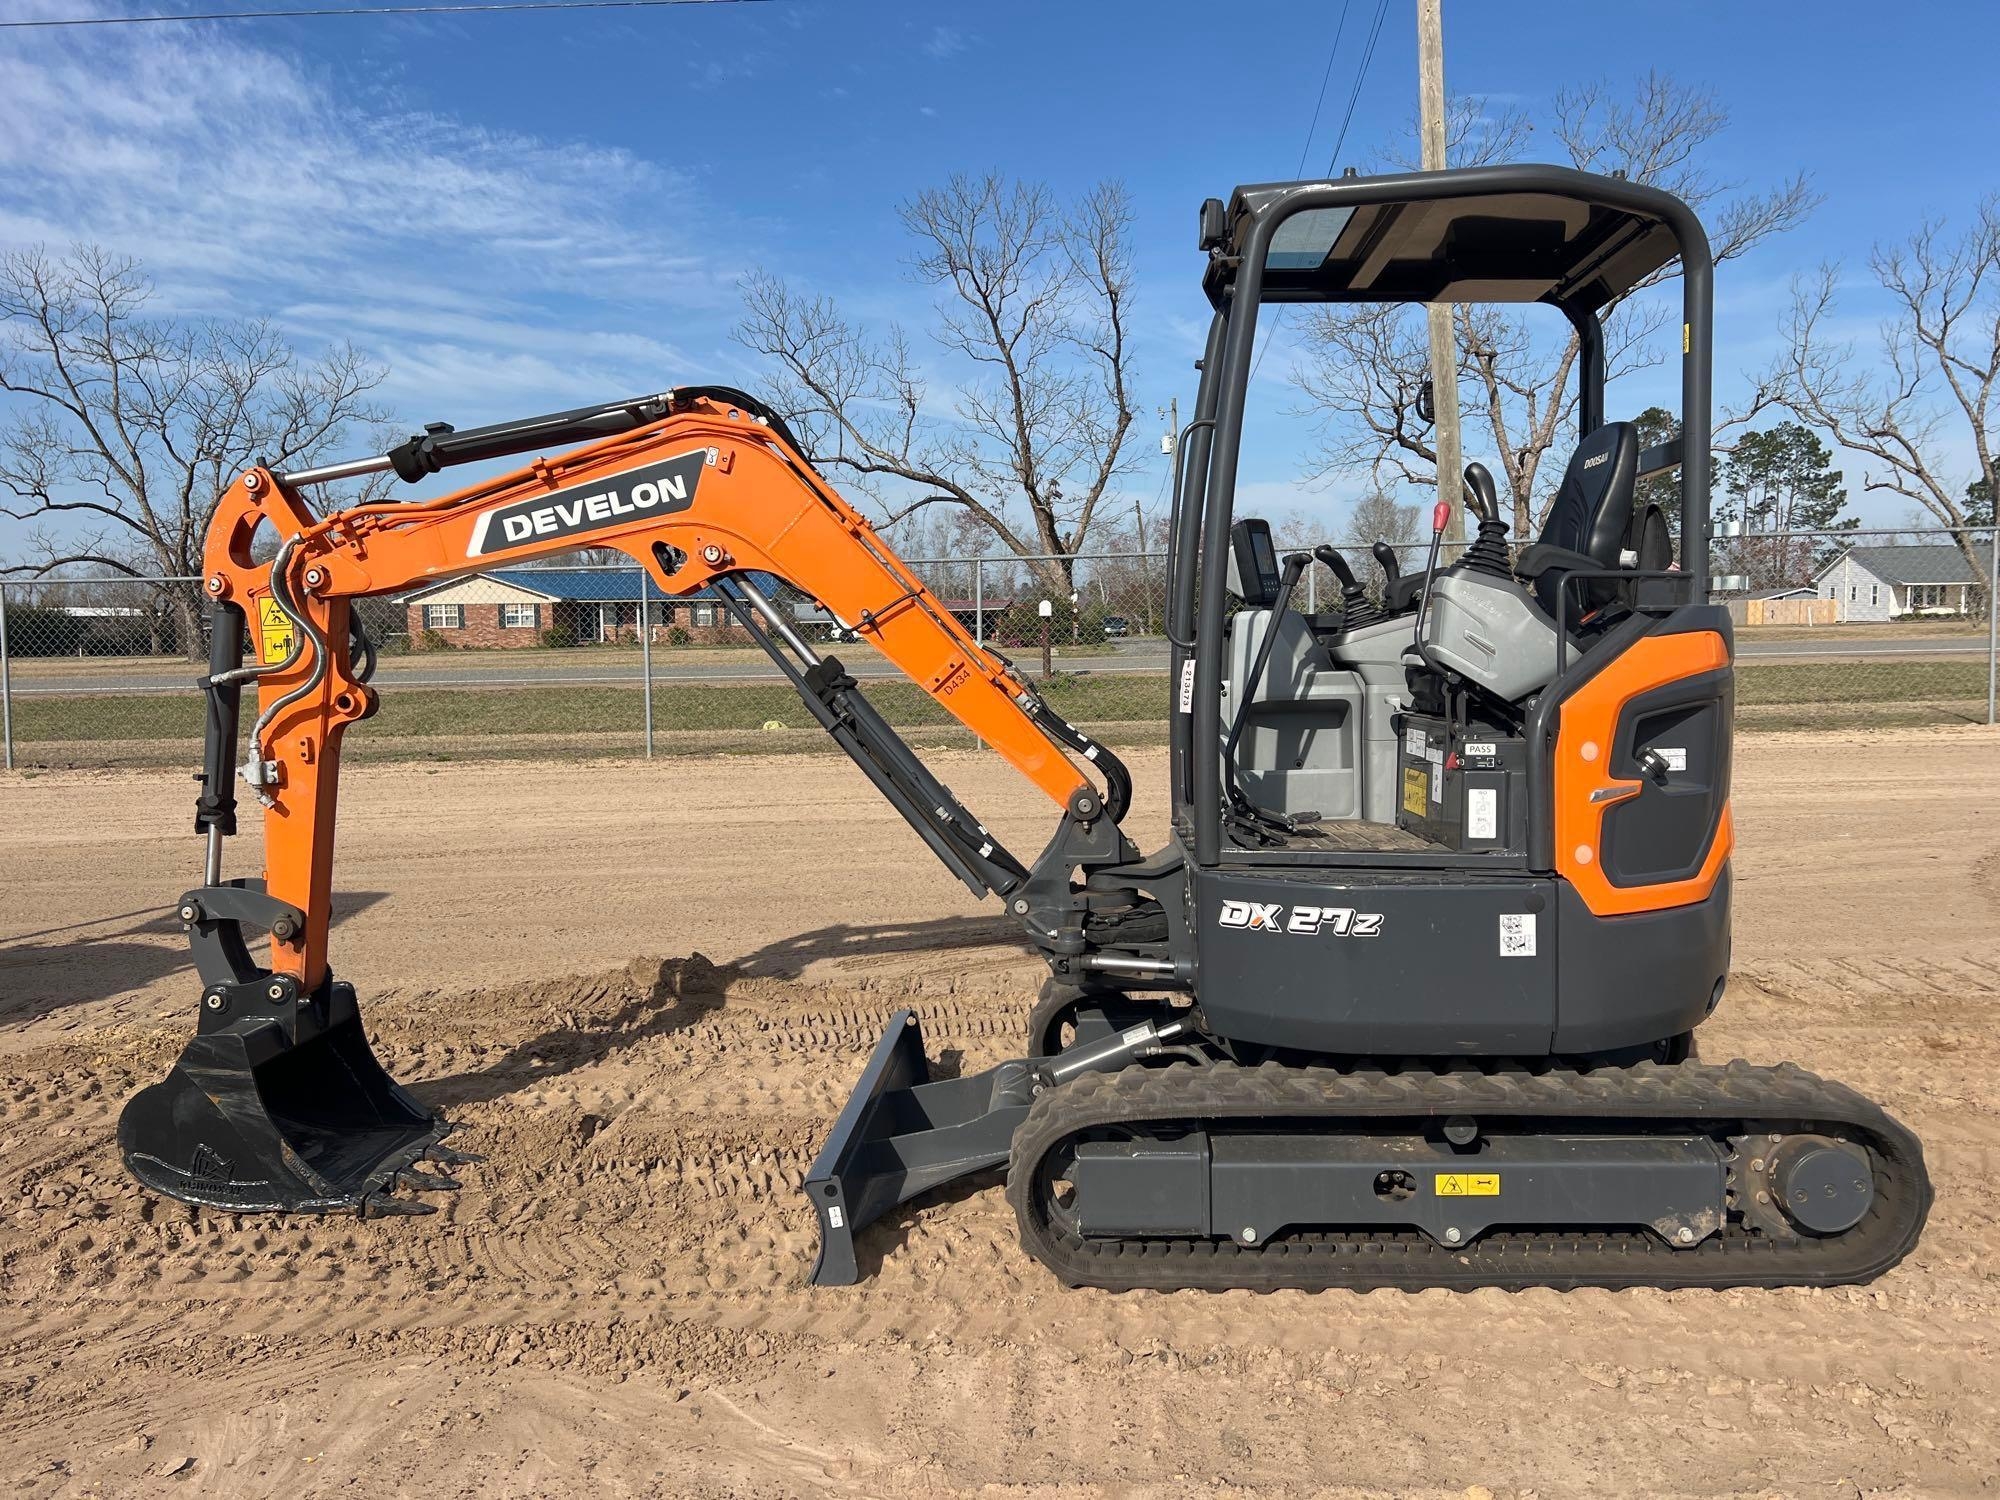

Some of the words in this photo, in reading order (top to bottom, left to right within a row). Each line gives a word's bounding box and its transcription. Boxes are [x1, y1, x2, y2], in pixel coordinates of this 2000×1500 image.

[502, 474, 688, 542] DEVELON
[943, 669, 971, 696] D434
[1469, 745, 1492, 753] PASS
[1218, 899, 1283, 933] DX
